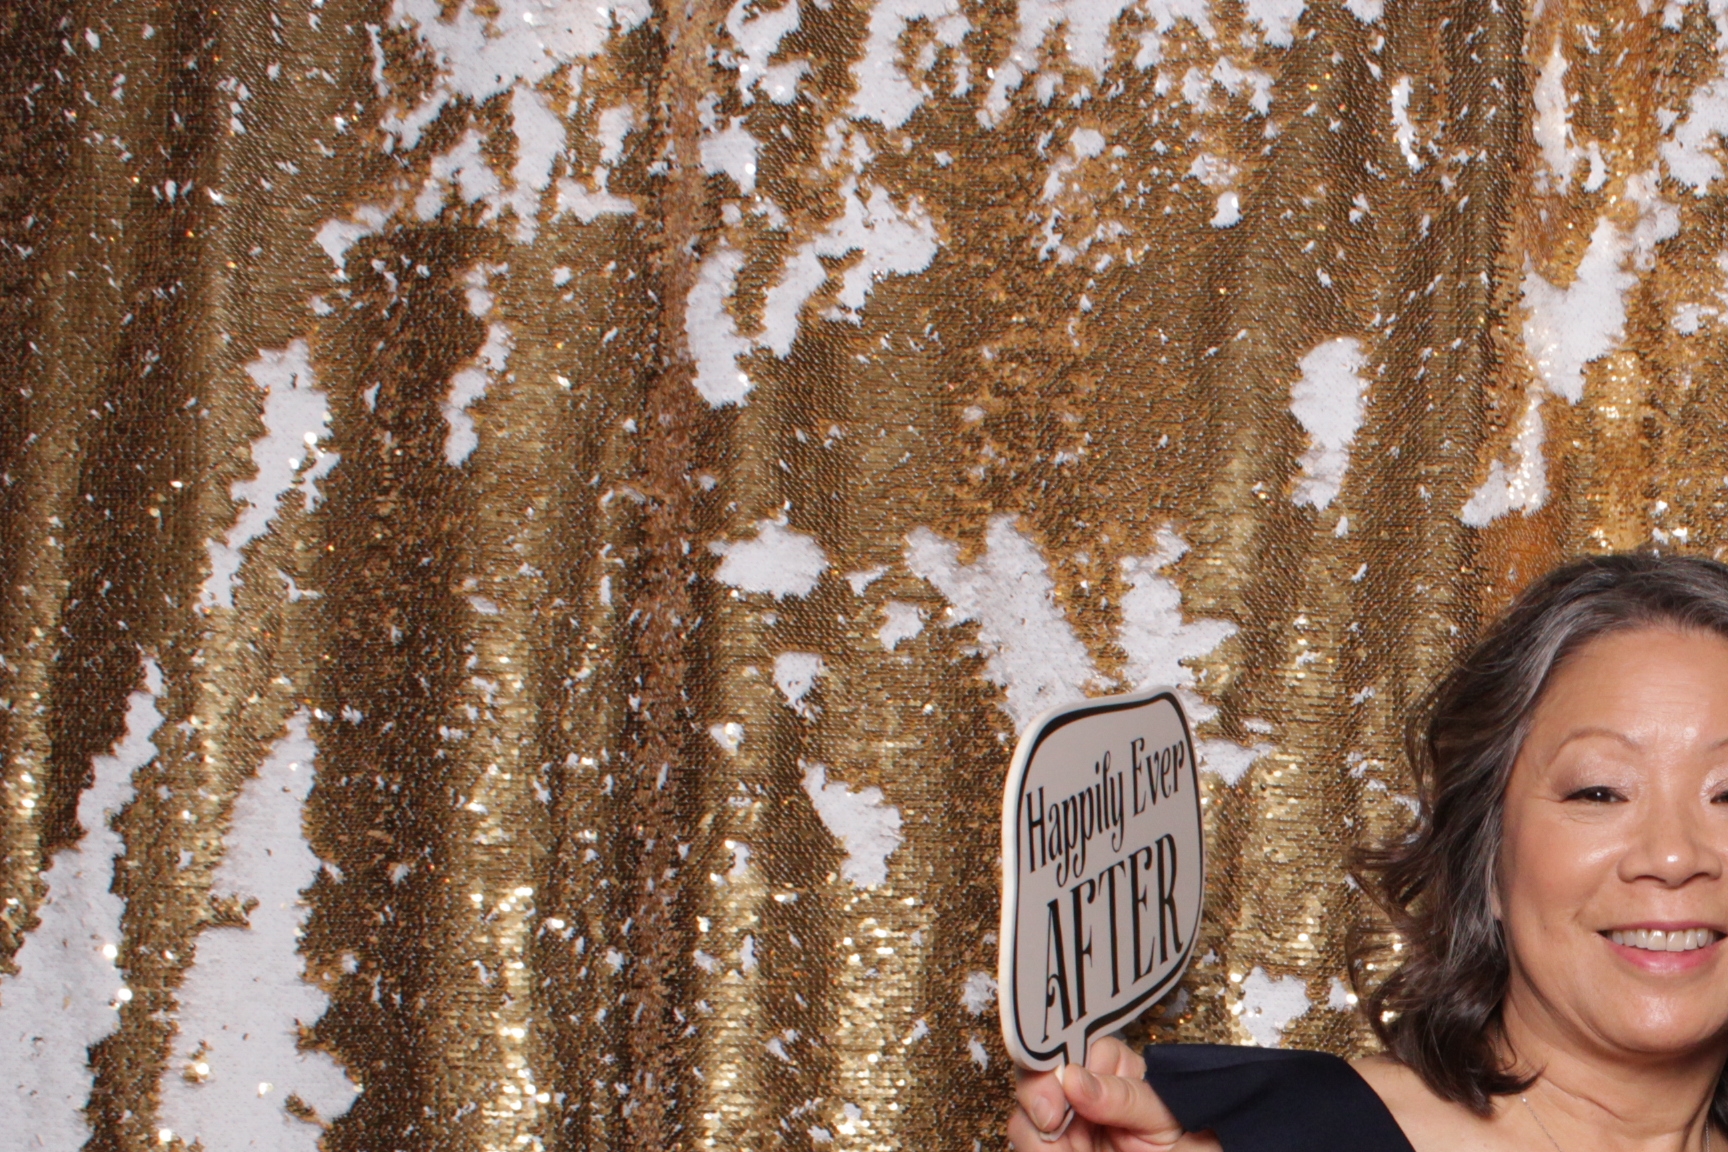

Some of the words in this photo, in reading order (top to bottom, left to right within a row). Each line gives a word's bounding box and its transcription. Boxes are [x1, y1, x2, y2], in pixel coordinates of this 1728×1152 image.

[1026, 750, 1123, 887] Happily
[1130, 737, 1184, 817] Ever
[1041, 833, 1183, 1044] AFTER
